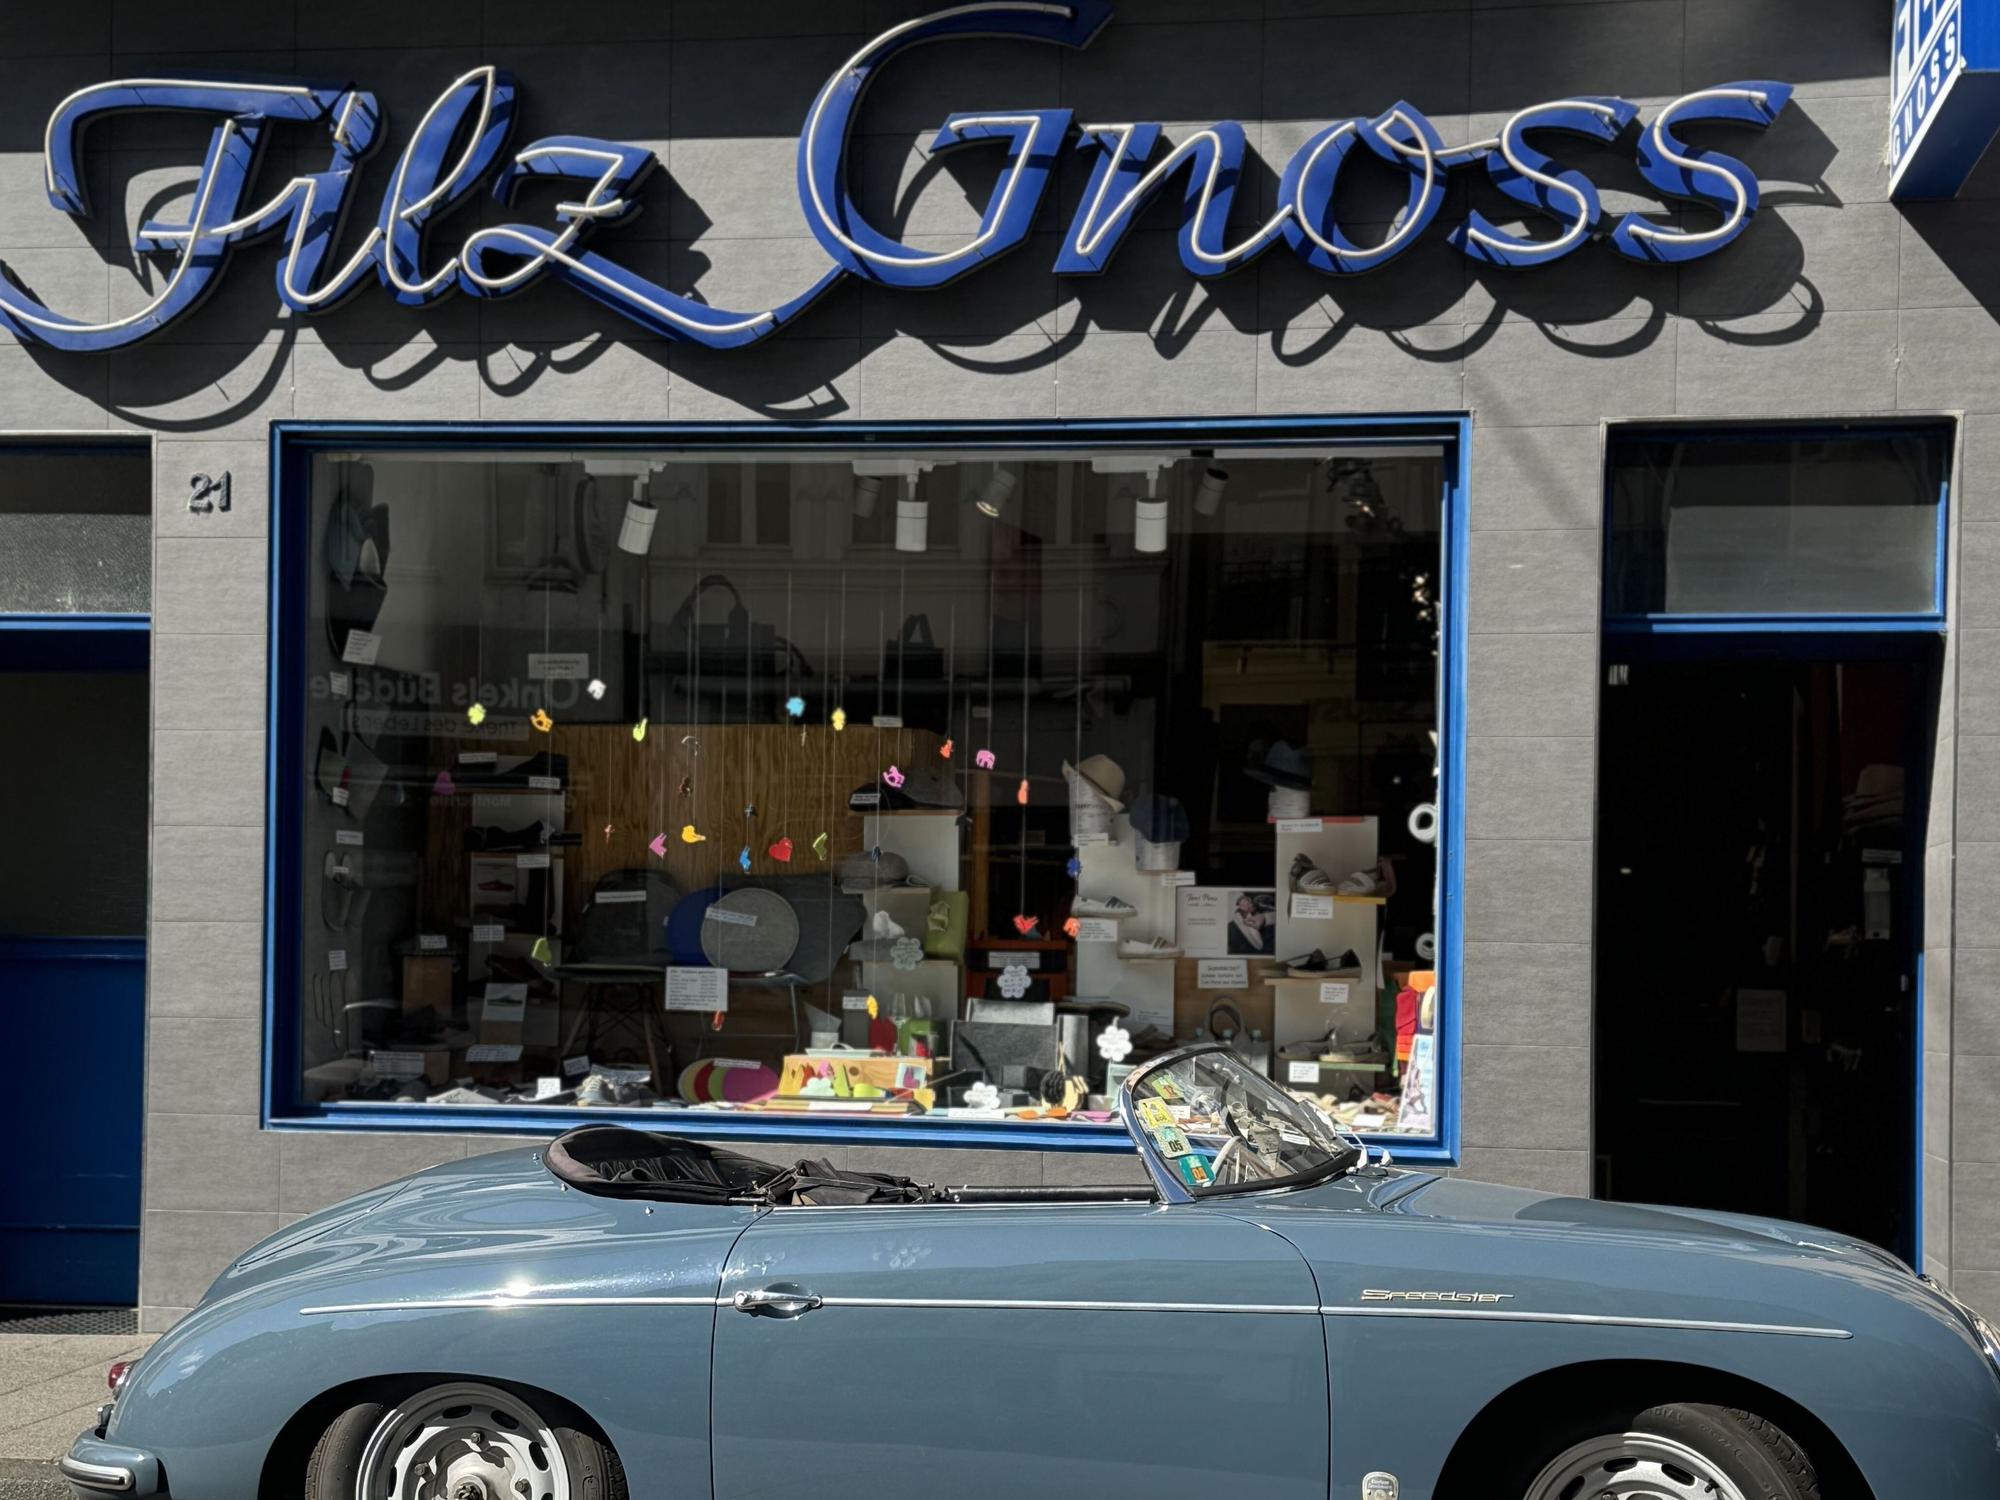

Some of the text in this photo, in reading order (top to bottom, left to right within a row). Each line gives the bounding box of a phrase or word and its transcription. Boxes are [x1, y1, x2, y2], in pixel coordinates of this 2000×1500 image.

[1892, 20, 1956, 166] GNOSS
[0, 0, 1795, 350] Filz Gnoss
[187, 470, 232, 514] 21
[1168, 1139, 1184, 1152] 05
[1360, 1288, 1515, 1304] Speedster
